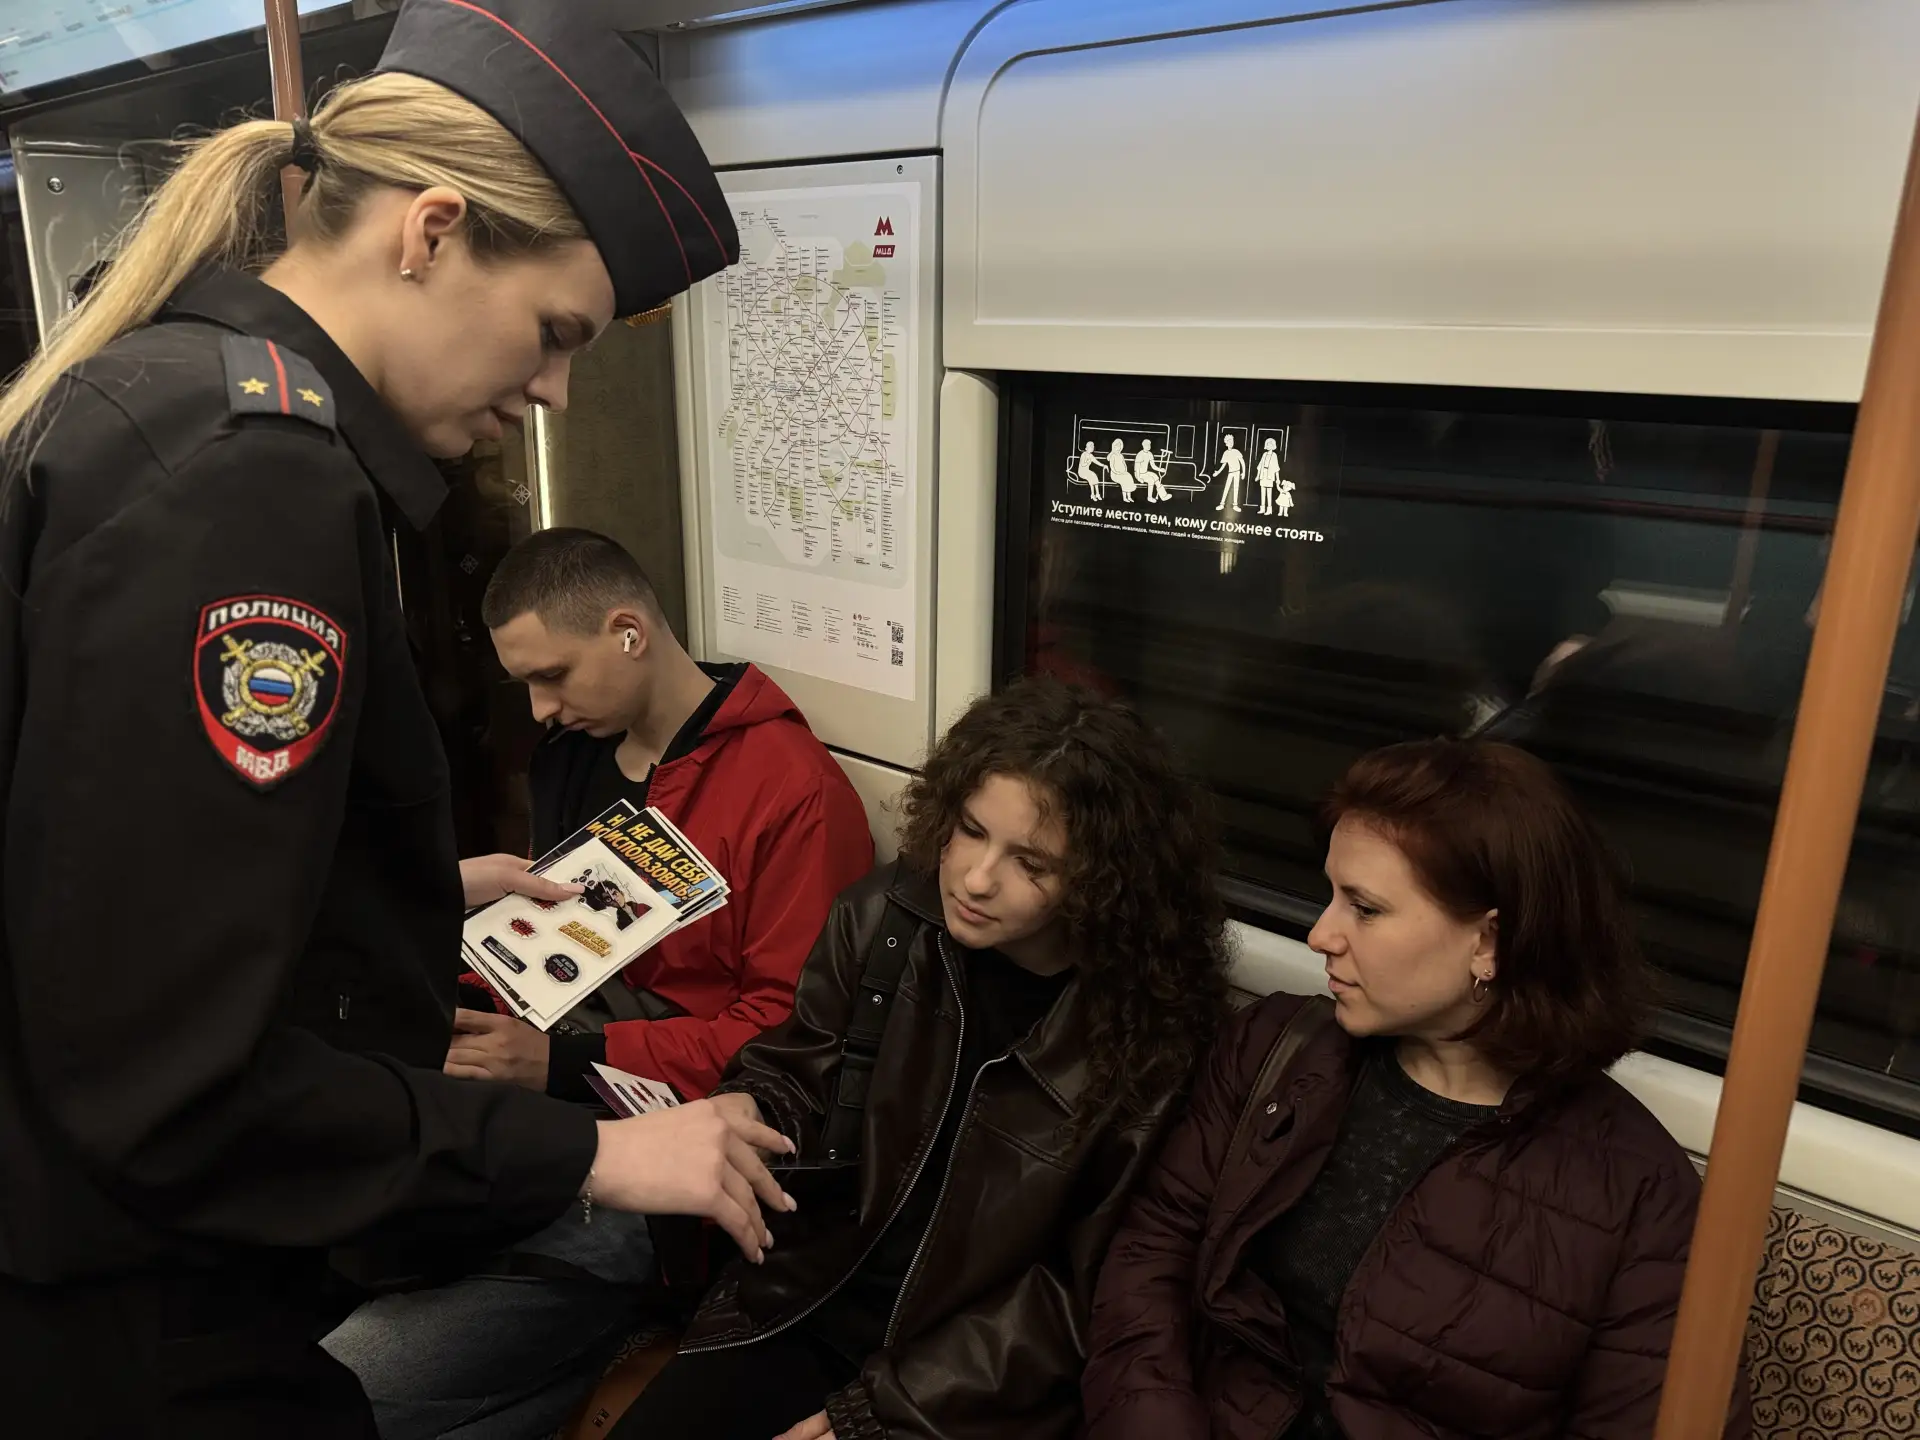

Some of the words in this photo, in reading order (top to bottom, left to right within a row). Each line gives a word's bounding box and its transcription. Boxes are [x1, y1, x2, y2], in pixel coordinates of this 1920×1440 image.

[1051, 500, 1103, 517] Уступите
[1105, 509, 1142, 522] место
[1144, 513, 1172, 527] тем,
[1175, 516, 1208, 532] кому
[1210, 520, 1273, 536] сложнее
[1275, 528, 1324, 543] стоять
[207, 600, 339, 649] ПОЛИЦИЯ
[235, 746, 290, 779] МВД
[603, 829, 704, 901] ИСПОЛЬЗОВАТЬ!
[626, 822, 656, 841] НЕ
[641, 838, 682, 861] ДАЙ
[670, 858, 709, 885] СЕБЯ
[553, 968, 568, 980] 102
